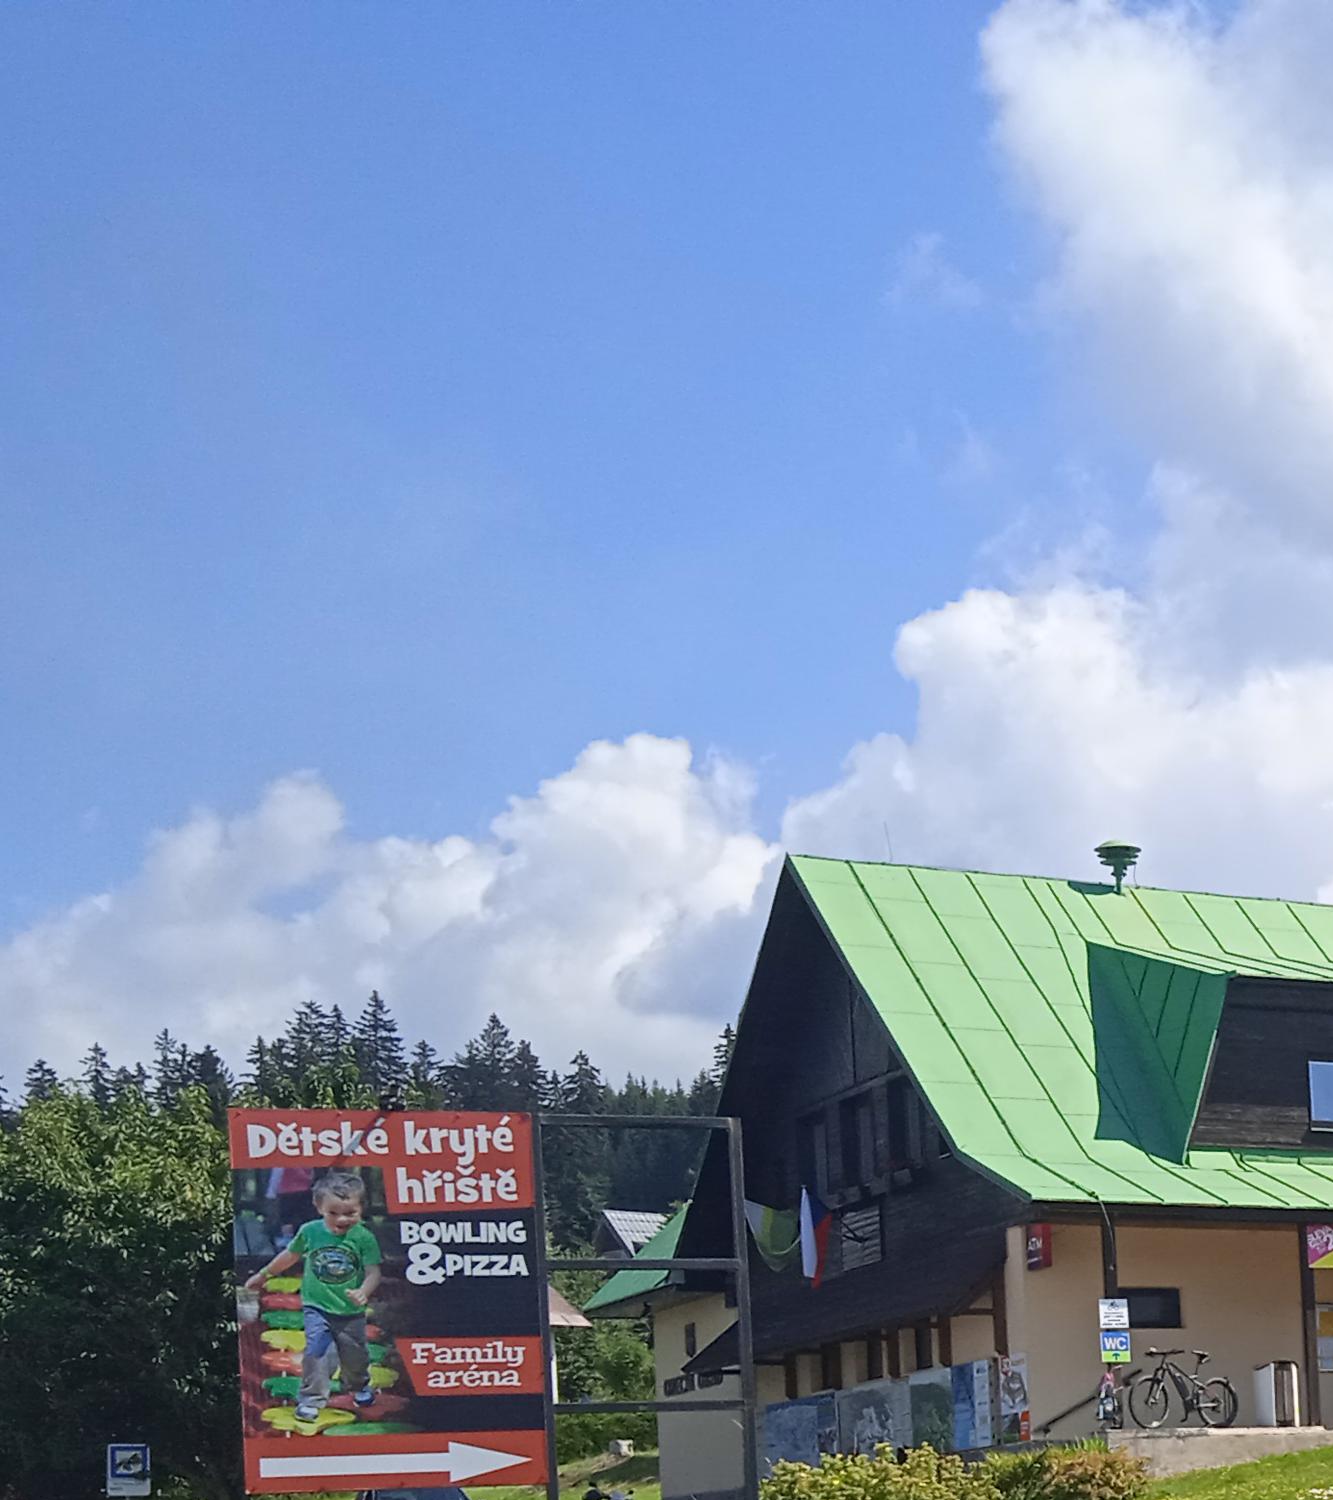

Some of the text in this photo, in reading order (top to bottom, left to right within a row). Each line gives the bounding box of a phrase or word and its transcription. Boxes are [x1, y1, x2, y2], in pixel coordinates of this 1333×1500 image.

[246, 1116, 514, 1165] Dětské kryté
[396, 1166, 519, 1204] hřiště
[401, 1221, 528, 1244] BOWLING
[411, 1341, 525, 1367] Family
[1103, 1336, 1128, 1351] WC
[427, 1364, 521, 1388] aréna
